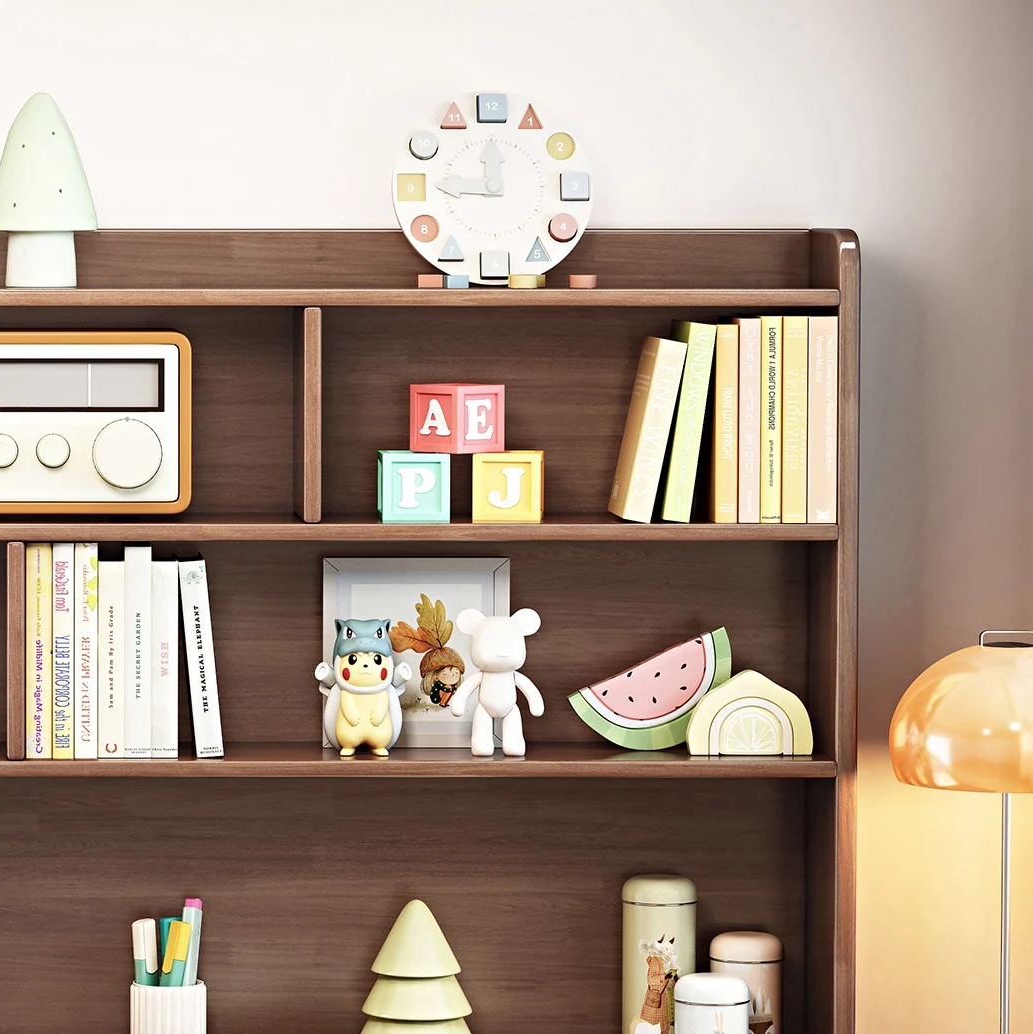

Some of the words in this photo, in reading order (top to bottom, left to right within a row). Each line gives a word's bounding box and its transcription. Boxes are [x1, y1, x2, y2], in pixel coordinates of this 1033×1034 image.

[485, 102, 498, 110] 12
[527, 117, 533, 126] 1
[418, 139, 430, 147] 10
[557, 142, 564, 151] 2
[407, 183, 414, 193] 9
[572, 182, 578, 190] 3
[421, 225, 428, 234] 8
[560, 223, 566, 231] 4
[534, 250, 541, 258] 5
[722, 387, 732, 409] FRANK
[419, 398, 451, 436] A
[465, 398, 494, 440] E
[722, 410, 732, 432] LLOYD
[722, 433, 732, 460] WRIGHT
[396, 468, 436, 509] P
[487, 468, 525, 509] J
[193, 605, 203, 650] ELEPHANT
[108, 648, 114, 656] By
[161, 642, 169, 677] WISH
[198, 654, 208, 692] MAGICAL
